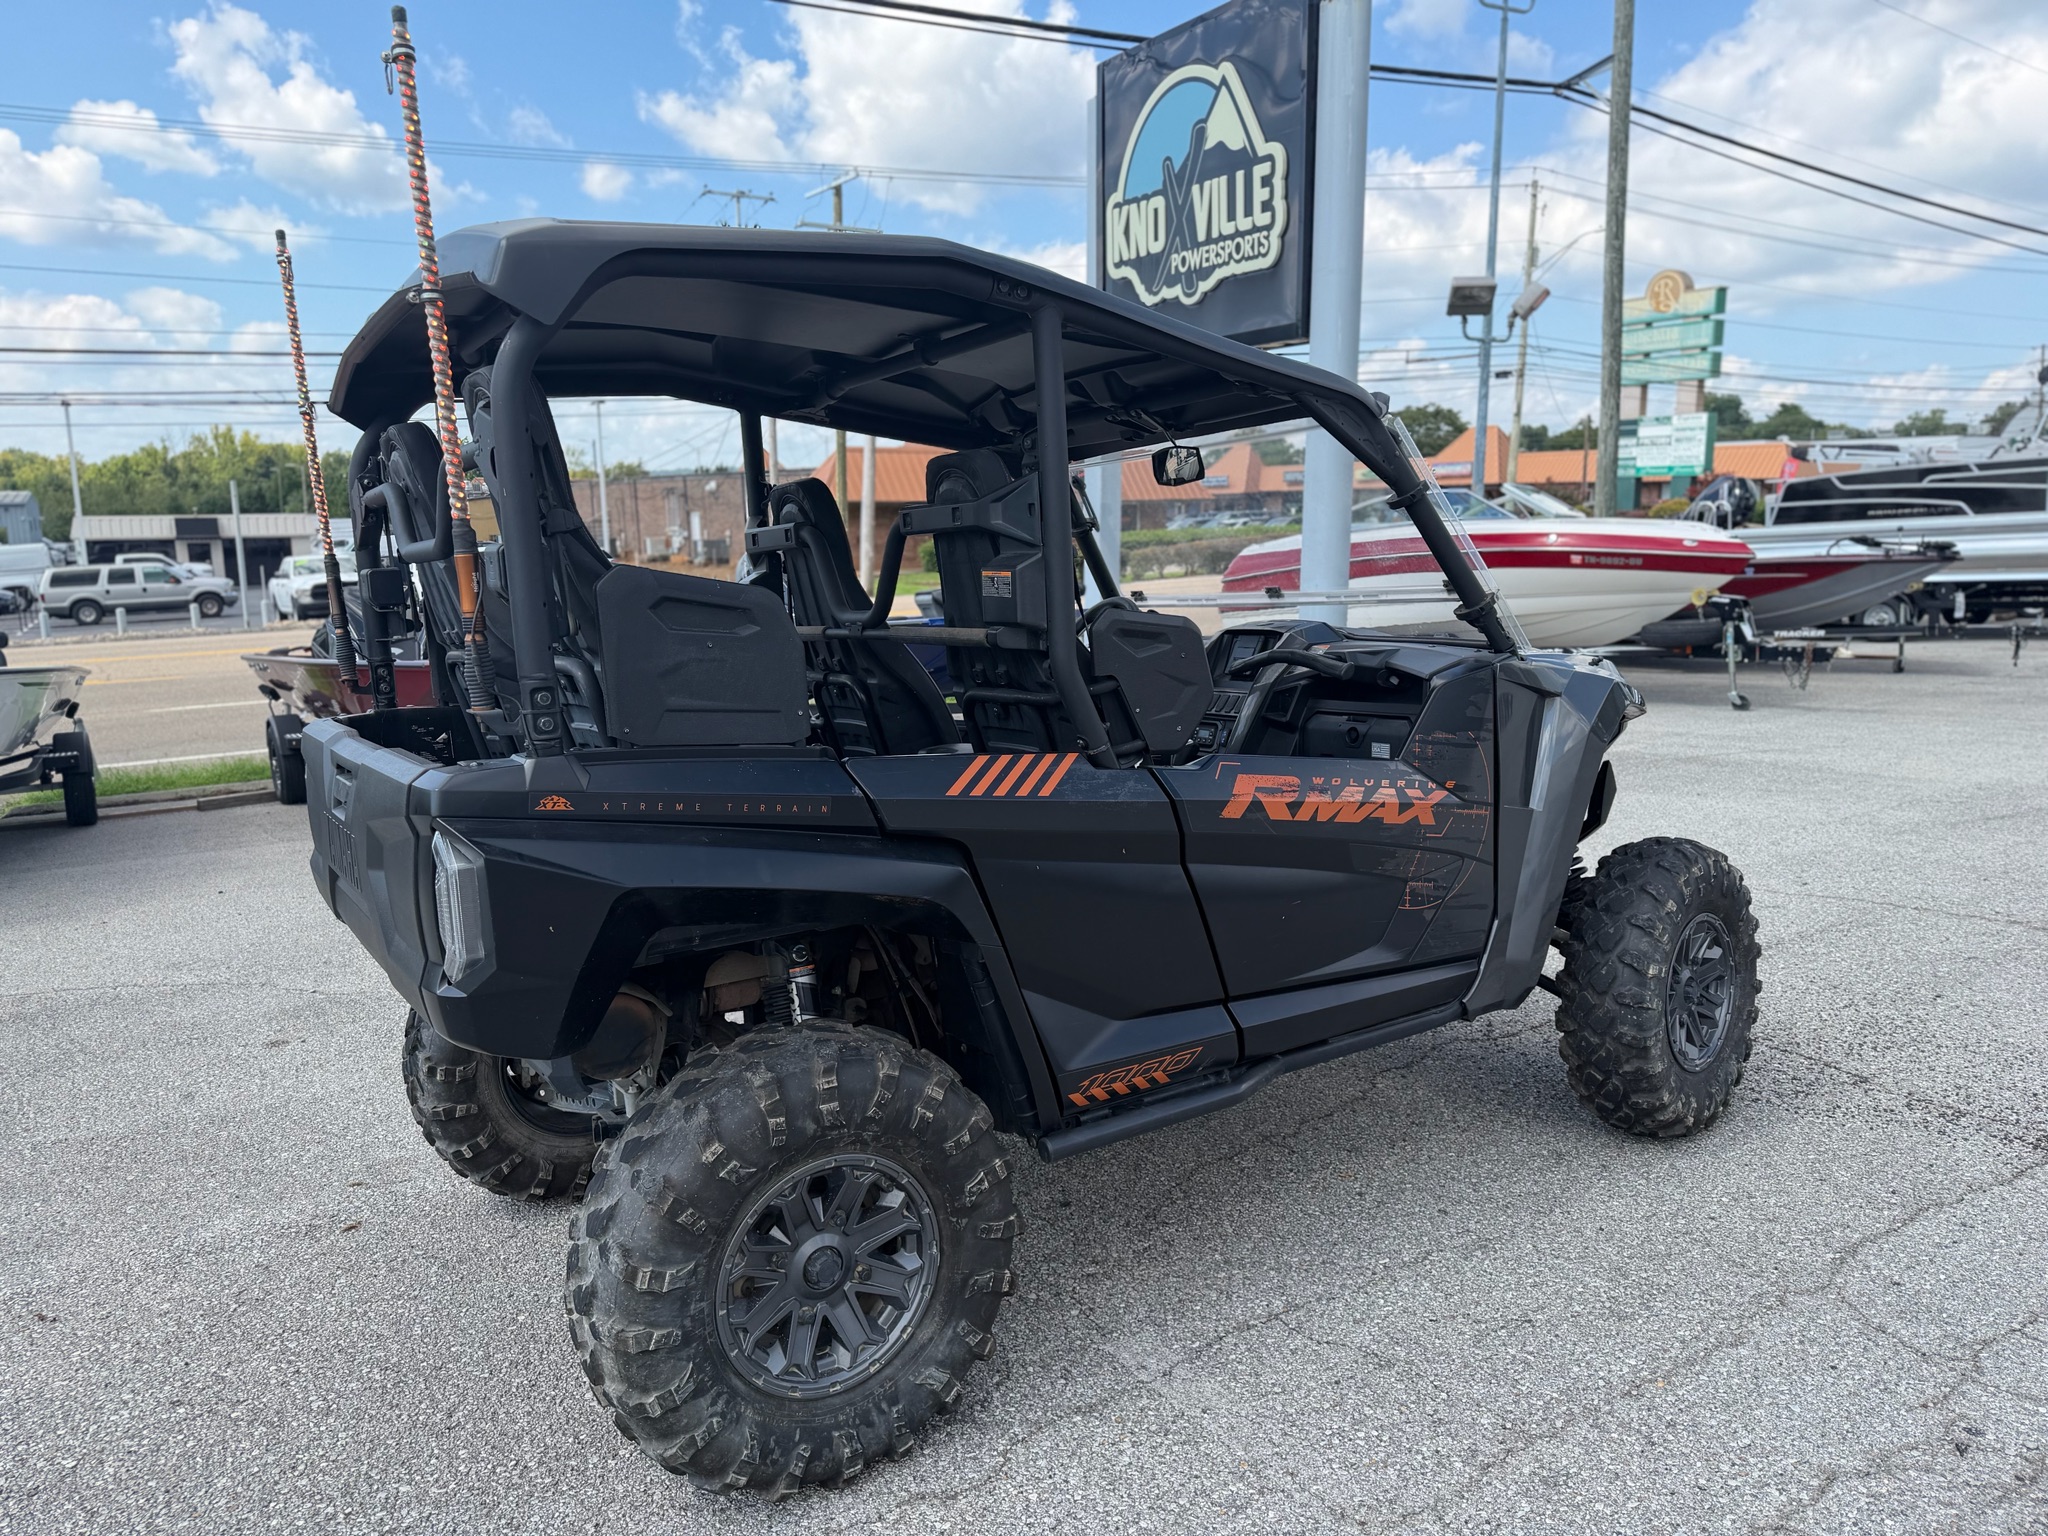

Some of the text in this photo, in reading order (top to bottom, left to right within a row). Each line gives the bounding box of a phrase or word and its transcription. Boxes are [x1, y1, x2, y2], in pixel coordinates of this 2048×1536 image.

[1112, 155, 1273, 270] KNOXVILLE
[1170, 230, 1269, 275] POWERSPORTS
[1773, 629, 1826, 638] TRACKER
[1219, 773, 1450, 826] RMAX
[1311, 776, 1456, 789] WOLVERINE
[602, 802, 828, 813] XTREME TERRAIN
[1078, 1046, 1204, 1097] 1000
